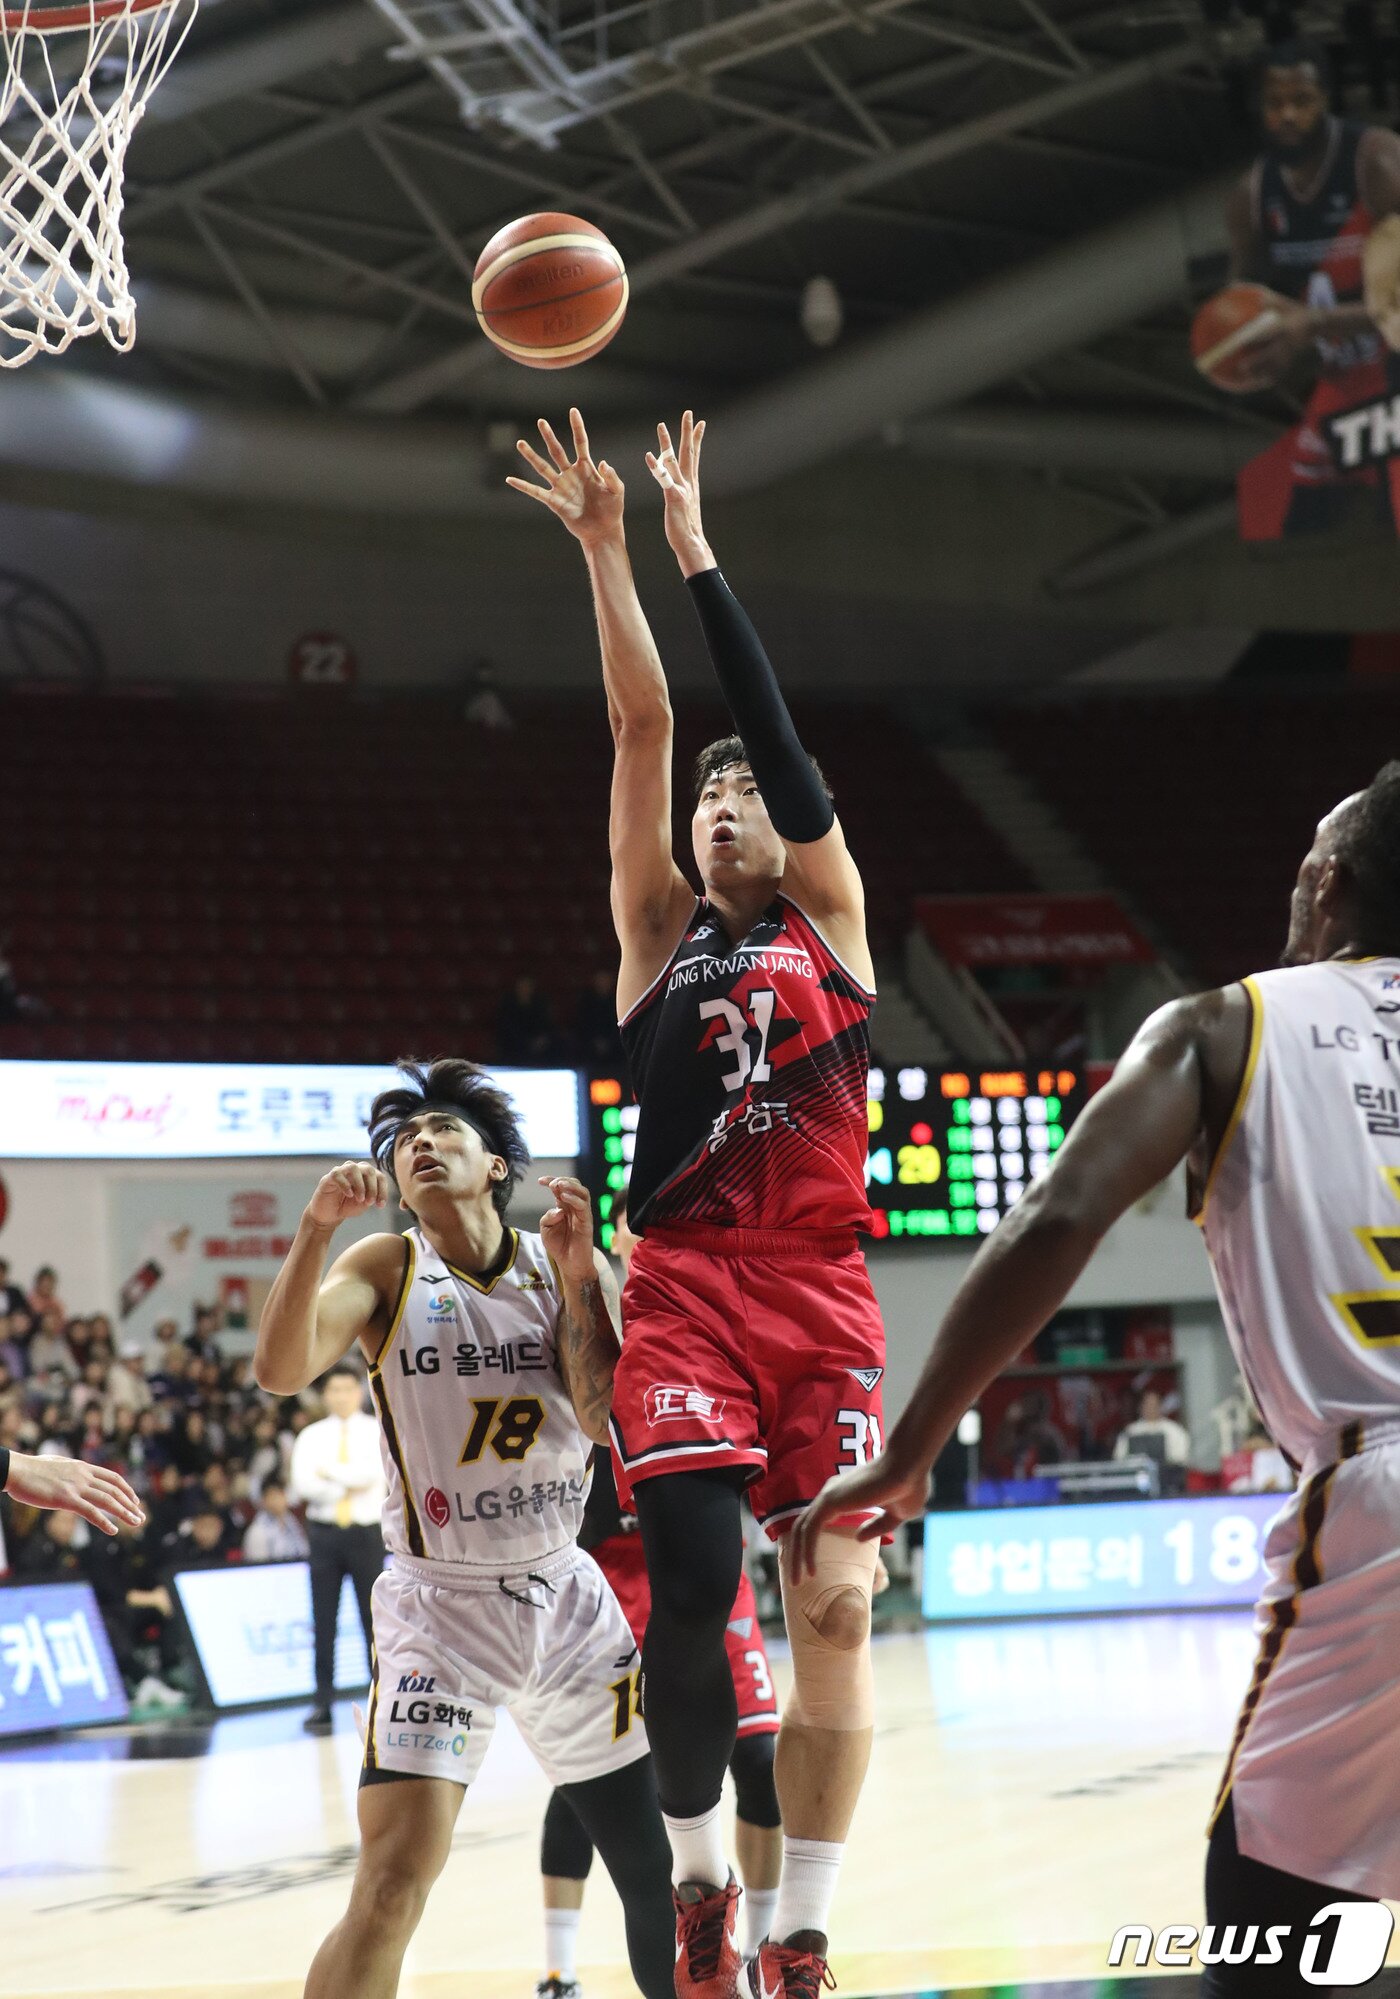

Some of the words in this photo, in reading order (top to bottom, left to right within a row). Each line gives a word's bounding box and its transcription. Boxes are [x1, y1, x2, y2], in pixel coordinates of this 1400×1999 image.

[299, 643, 345, 683] 22
[702, 954, 768, 983] KWAN
[769, 955, 813, 979] JANG
[698, 989, 775, 1093] 31
[1310, 1023, 1361, 1052] LG
[1353, 1083, 1400, 1138] 텔
[399, 1345, 441, 1377] LG
[452, 1343, 549, 1377] 올레드
[456, 1394, 548, 1469] 18
[834, 1408, 884, 1476] 31
[1163, 1514, 1262, 1586] 18
[0, 1610, 111, 1707] 커피
[396, 1669, 437, 1694] KBL
[744, 1649, 774, 1701] 3
[608, 1667, 646, 1744] 1
